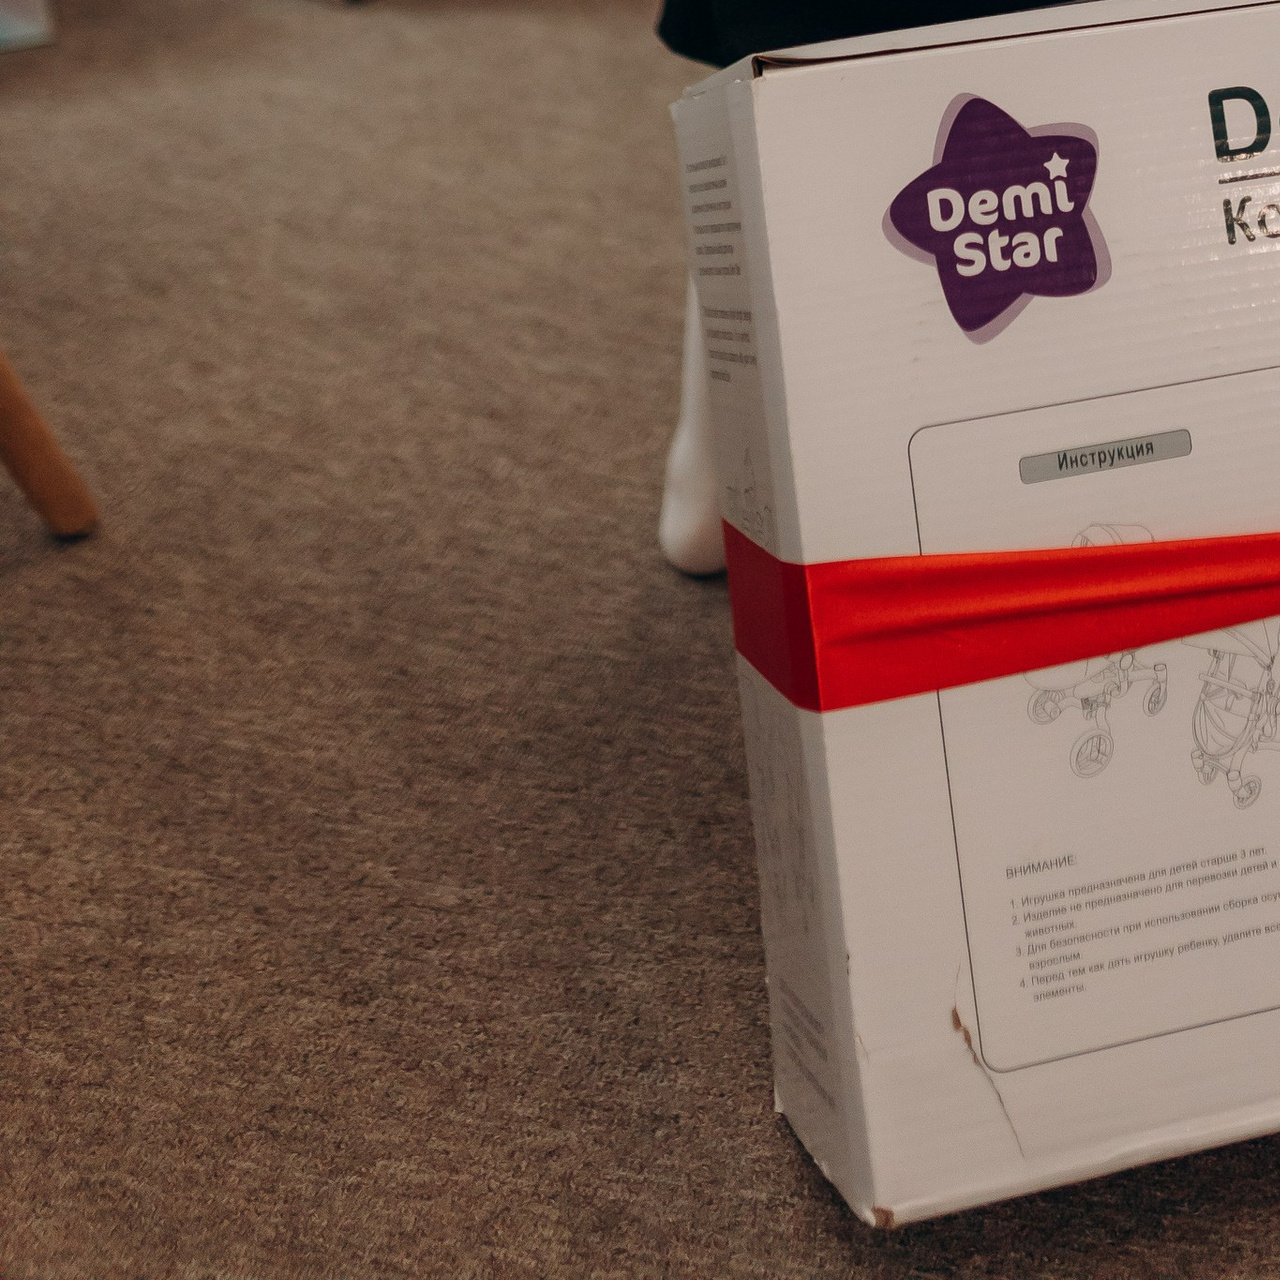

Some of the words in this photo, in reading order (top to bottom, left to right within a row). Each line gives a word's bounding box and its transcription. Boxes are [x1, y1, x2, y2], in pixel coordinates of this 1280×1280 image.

[927, 159, 1074, 232] Demi
[953, 227, 1064, 277] Star
[1057, 441, 1155, 472] Инструкция
[1020, 889, 1066, 907] Игрушка
[1067, 872, 1146, 897] предназначена
[1147, 867, 1167, 881] для
[1168, 859, 1198, 877] детей
[1199, 852, 1238, 868] старше
[1240, 848, 1246, 860] 3
[1022, 905, 1067, 923] Изделие
[1069, 902, 1082, 912] не
[1084, 885, 1163, 910] предназначено
[1164, 880, 1184, 893] для
[1185, 867, 1238, 887] перевозки
[1239, 860, 1269, 877] детей
[1270, 859, 1277, 869] и
[1026, 942, 1047, 956] Для
[1048, 925, 1120, 950] безопасности
[1122, 921, 1142, 934] при
[1143, 903, 1221, 929] использовании
[1222, 895, 1259, 911] сборка
[1030, 971, 1065, 986] Перед
[1067, 966, 1086, 977] тем
[1088, 962, 1105, 973] как
[1107, 957, 1131, 970] дать
[1133, 945, 1175, 963] игрушку
[1221, 927, 1262, 946] удалите
